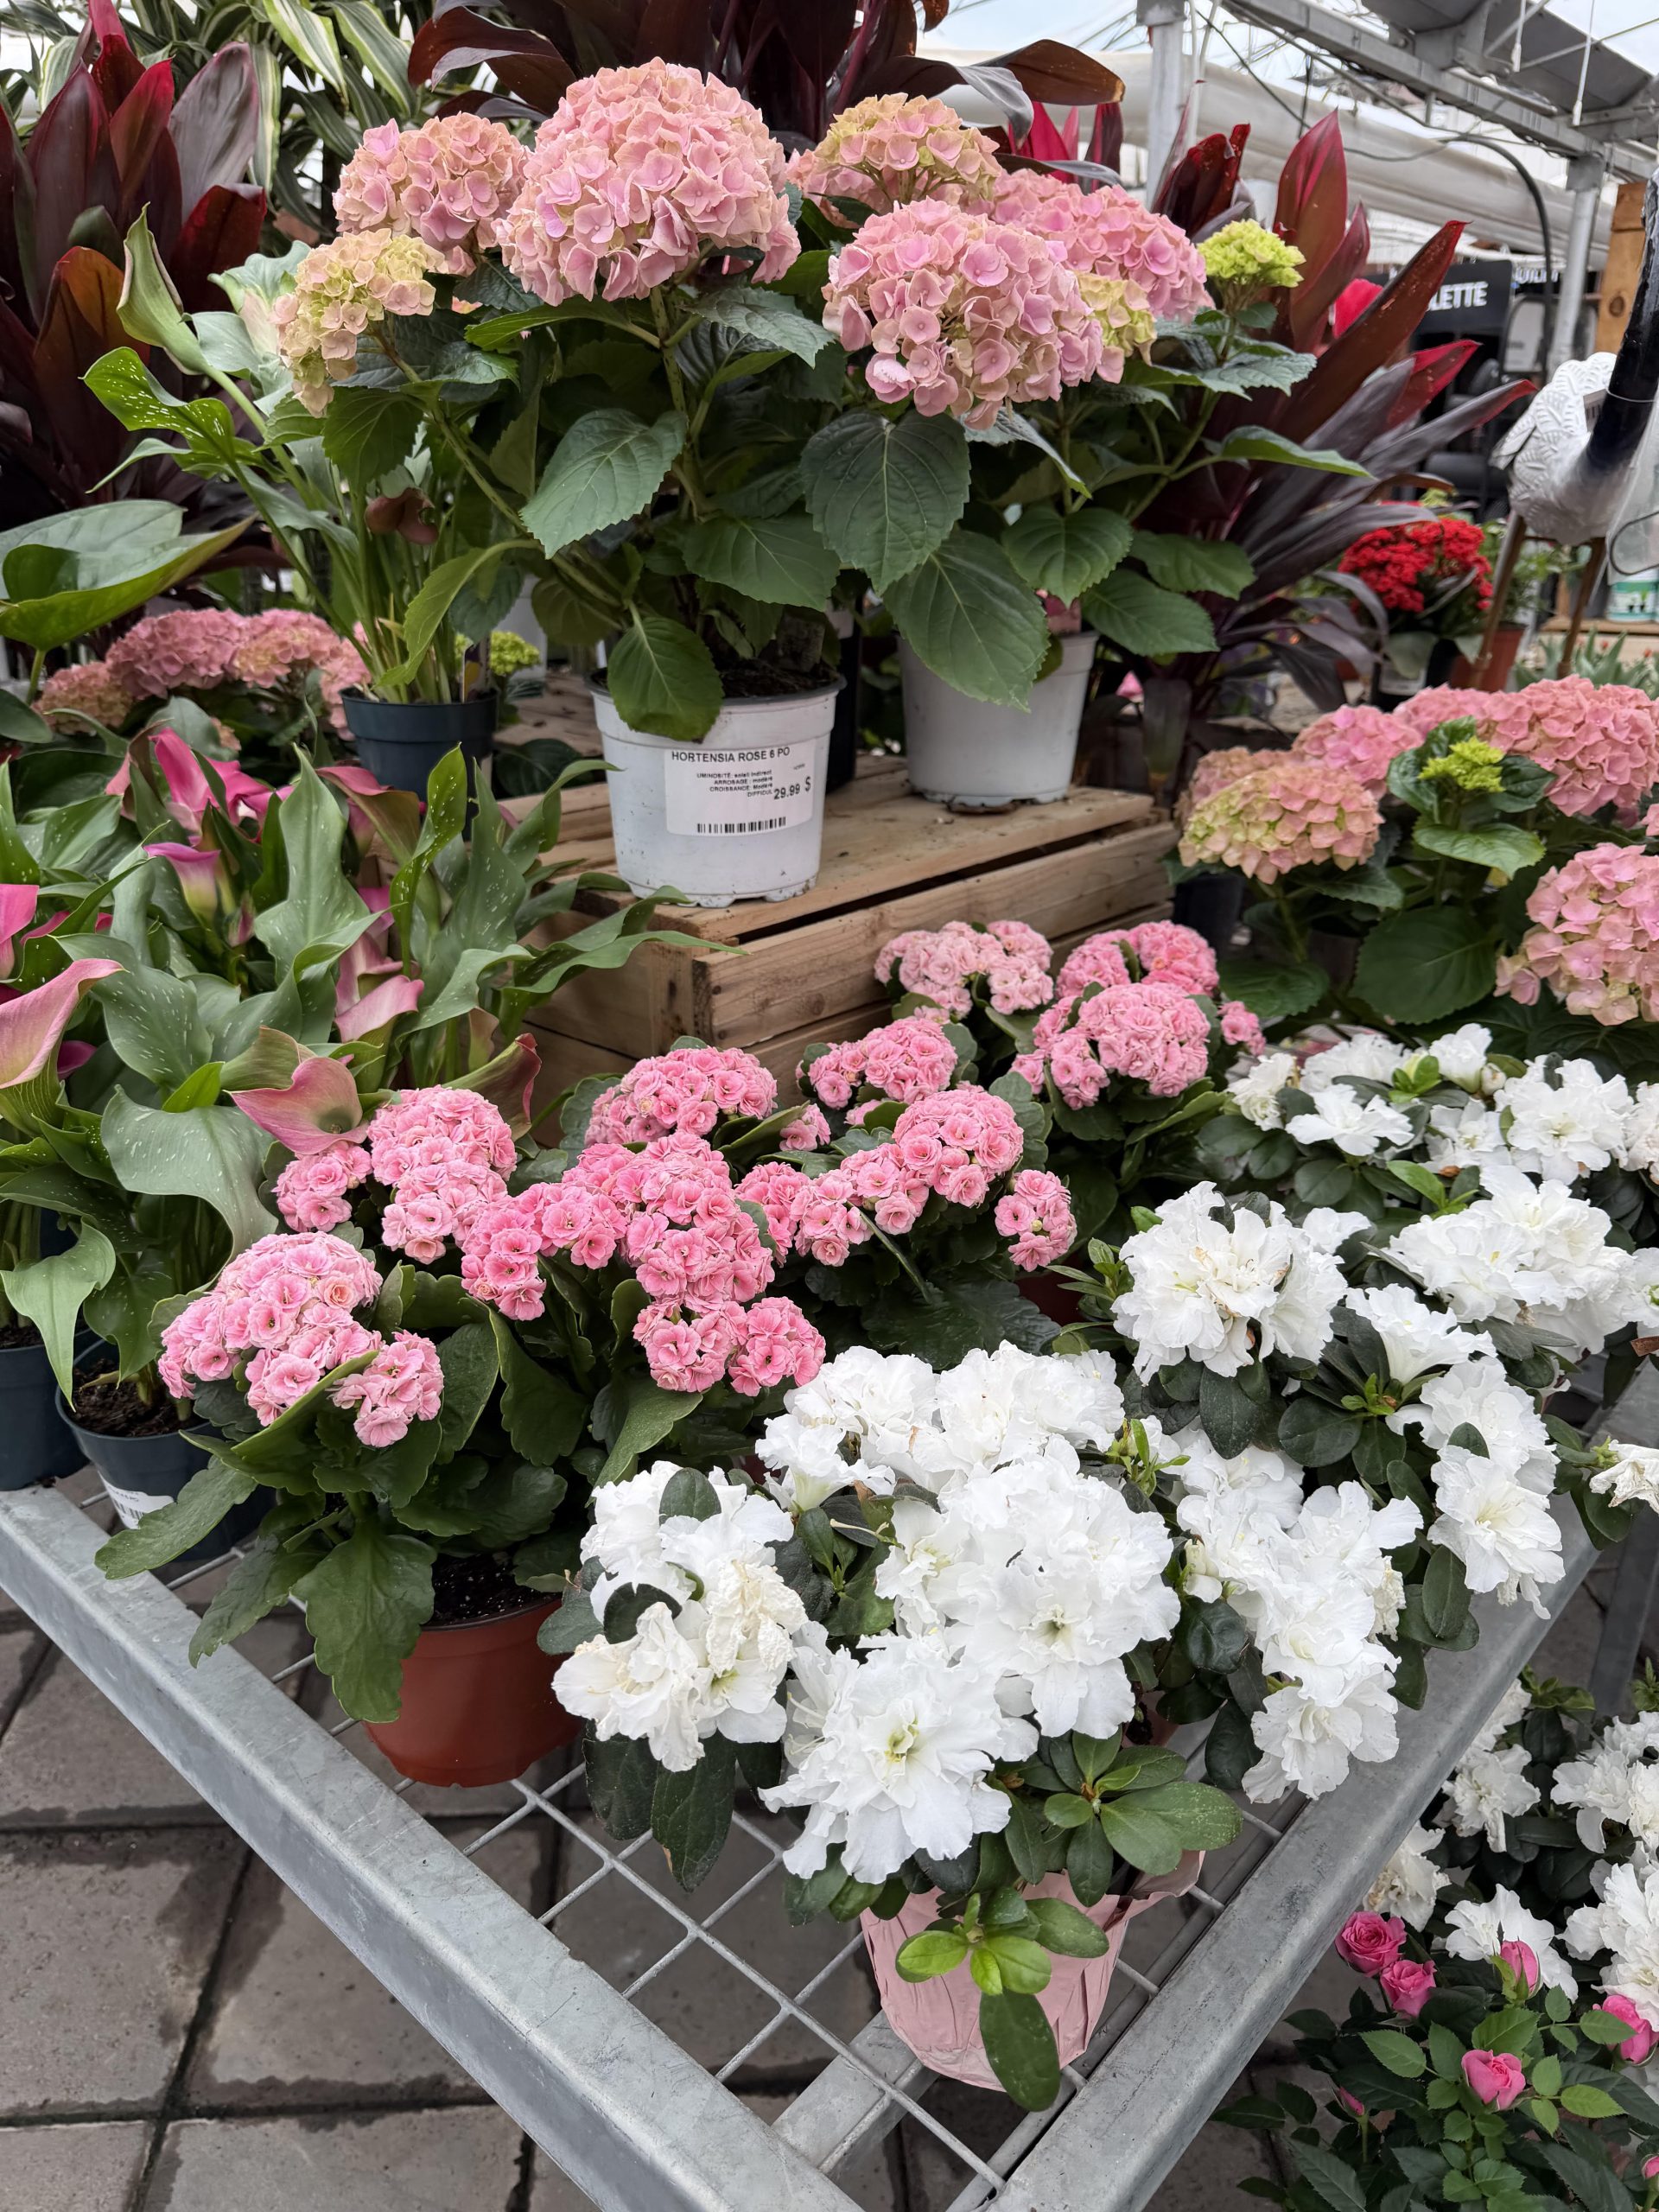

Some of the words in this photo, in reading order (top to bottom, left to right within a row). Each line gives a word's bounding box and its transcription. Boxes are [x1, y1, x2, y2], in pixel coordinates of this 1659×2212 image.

[671, 751, 734, 762] HORTENSIA
[738, 750, 766, 762] ROSE
[769, 749, 775, 759] 6
[778, 747, 790, 758] PO
[774, 783, 800, 800] 29.99
[805, 776, 811, 792] $
